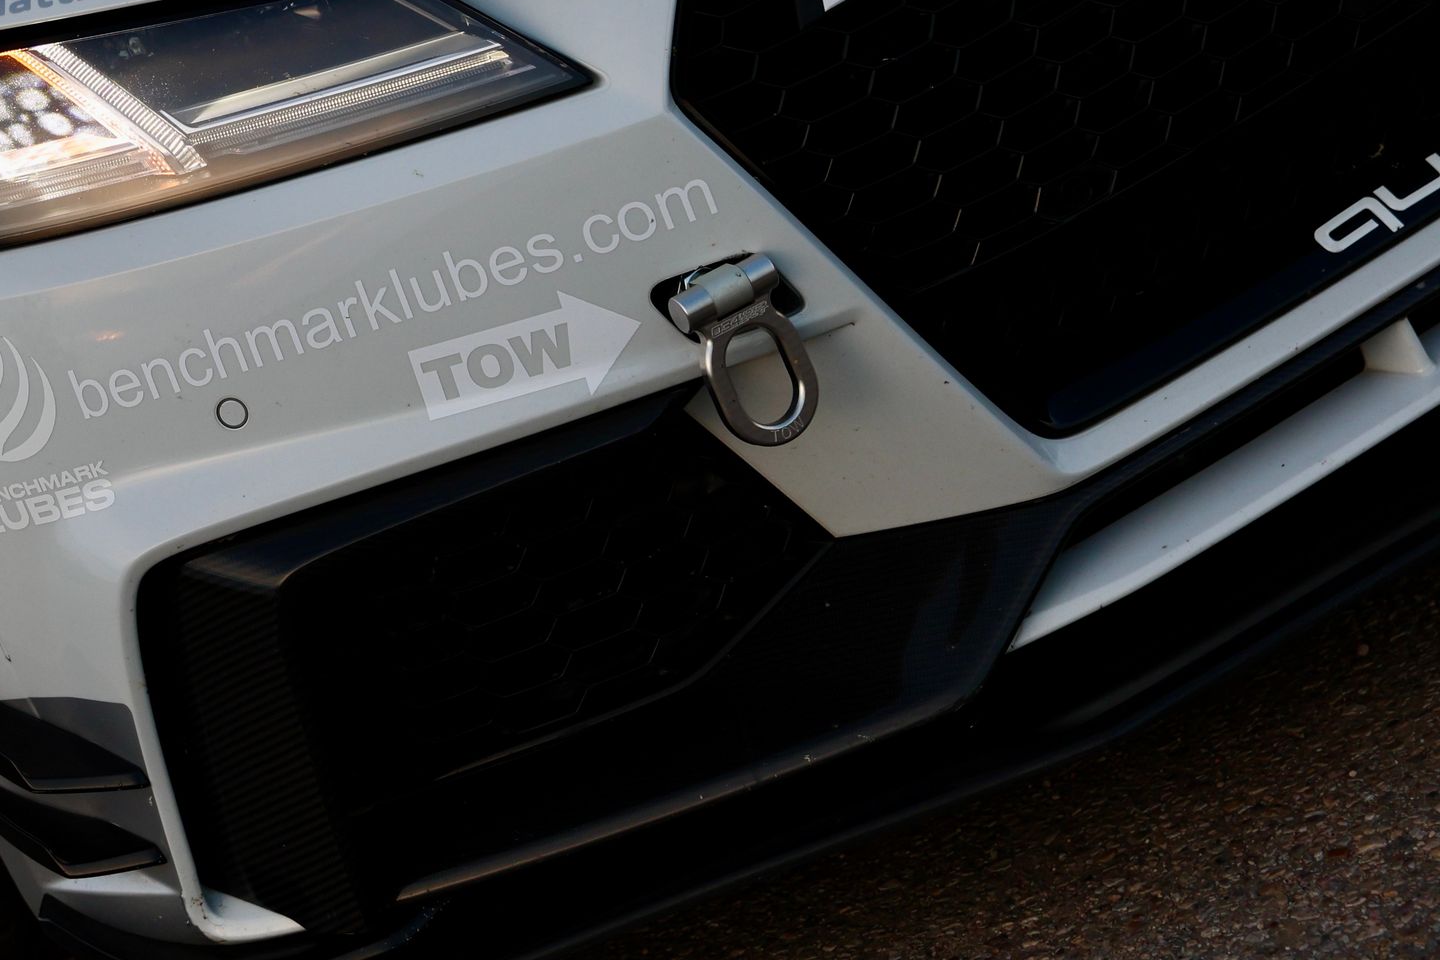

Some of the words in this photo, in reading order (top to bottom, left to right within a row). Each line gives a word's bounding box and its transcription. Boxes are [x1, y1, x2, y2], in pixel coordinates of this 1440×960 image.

[68, 179, 718, 419] benchmarklubes.com
[420, 322, 572, 401] TOW
[770, 416, 804, 443] TOW
